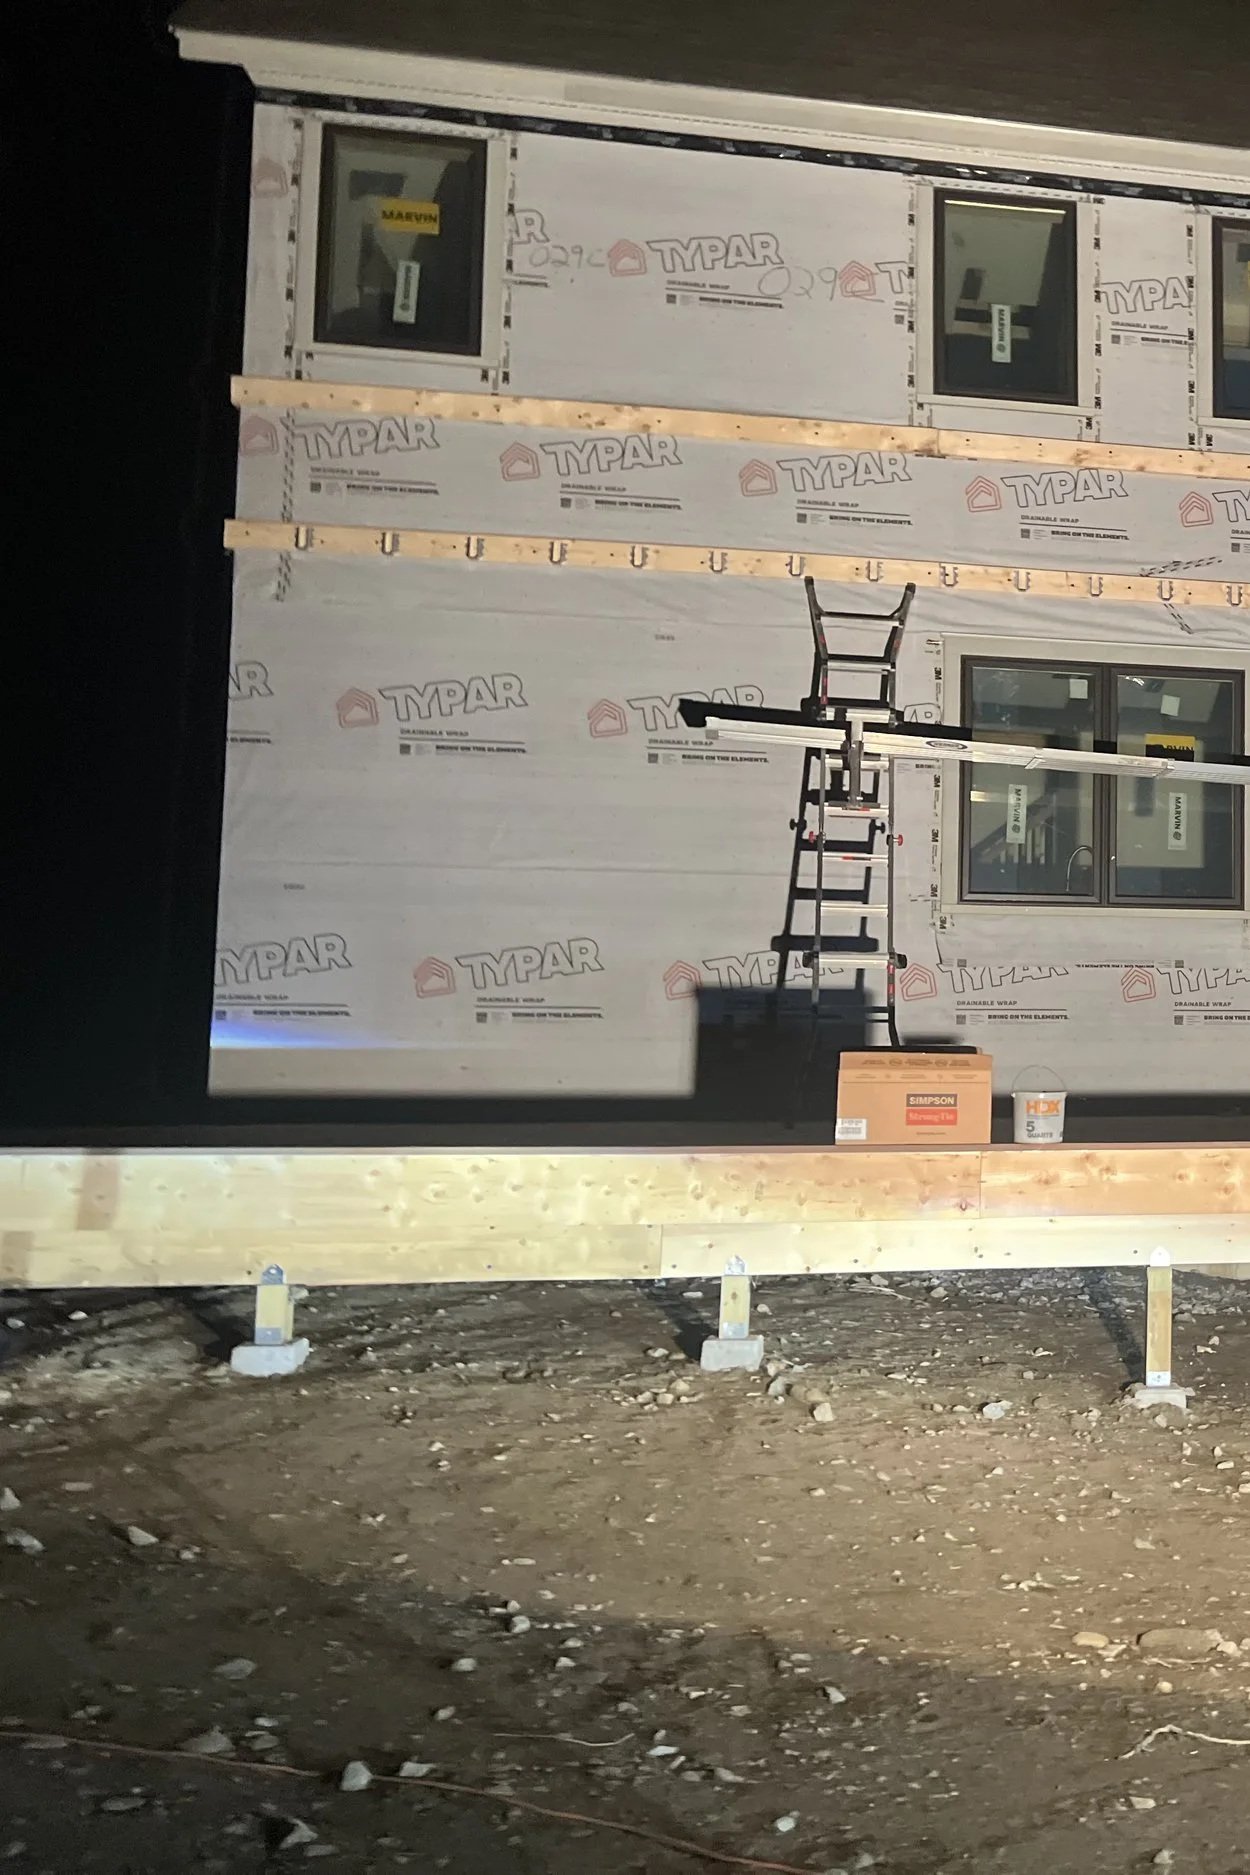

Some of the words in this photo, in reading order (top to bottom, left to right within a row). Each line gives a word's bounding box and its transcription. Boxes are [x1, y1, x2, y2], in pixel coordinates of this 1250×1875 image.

[381, 210, 437, 224] MARVIN
[646, 232, 784, 273] TYPAR
[1101, 276, 1191, 314] TYPA
[280, 416, 440, 460] TYPAR
[539, 434, 683, 476] TYPAR
[776, 452, 912, 492] TYPAR
[1000, 468, 1129, 508] TYPAR
[1020, 514, 1058, 522] DRAINABLE
[378, 672, 528, 722] TYPAR
[1013, 788, 1022, 825] MARVIN
[1174, 796, 1182, 830] MARVIN
[932, 828, 939, 842] 3M
[930, 884, 938, 898] 3M
[938, 916, 947, 930] 3M
[454, 937, 604, 990] TYPAR
[909, 1096, 955, 1105] SIMPSON
[1026, 1100, 1060, 1114] HDX
[1026, 1121, 1035, 1132] 5
